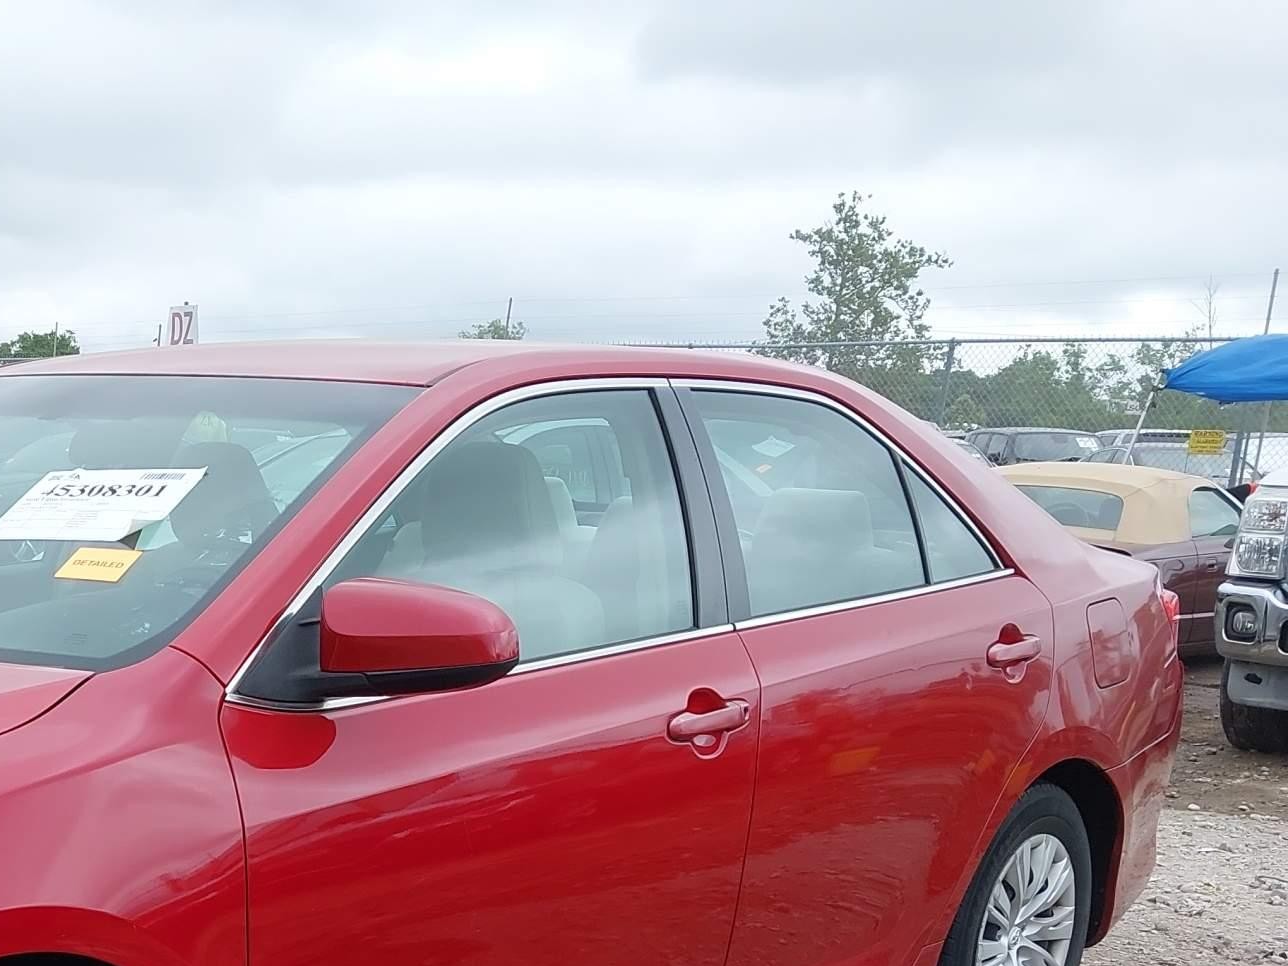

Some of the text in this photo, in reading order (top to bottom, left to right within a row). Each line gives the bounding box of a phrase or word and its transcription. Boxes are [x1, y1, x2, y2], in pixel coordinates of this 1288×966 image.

[170, 311, 194, 345] DZ
[41, 484, 168, 497] 45308301
[72, 559, 125, 569] DETAILED
